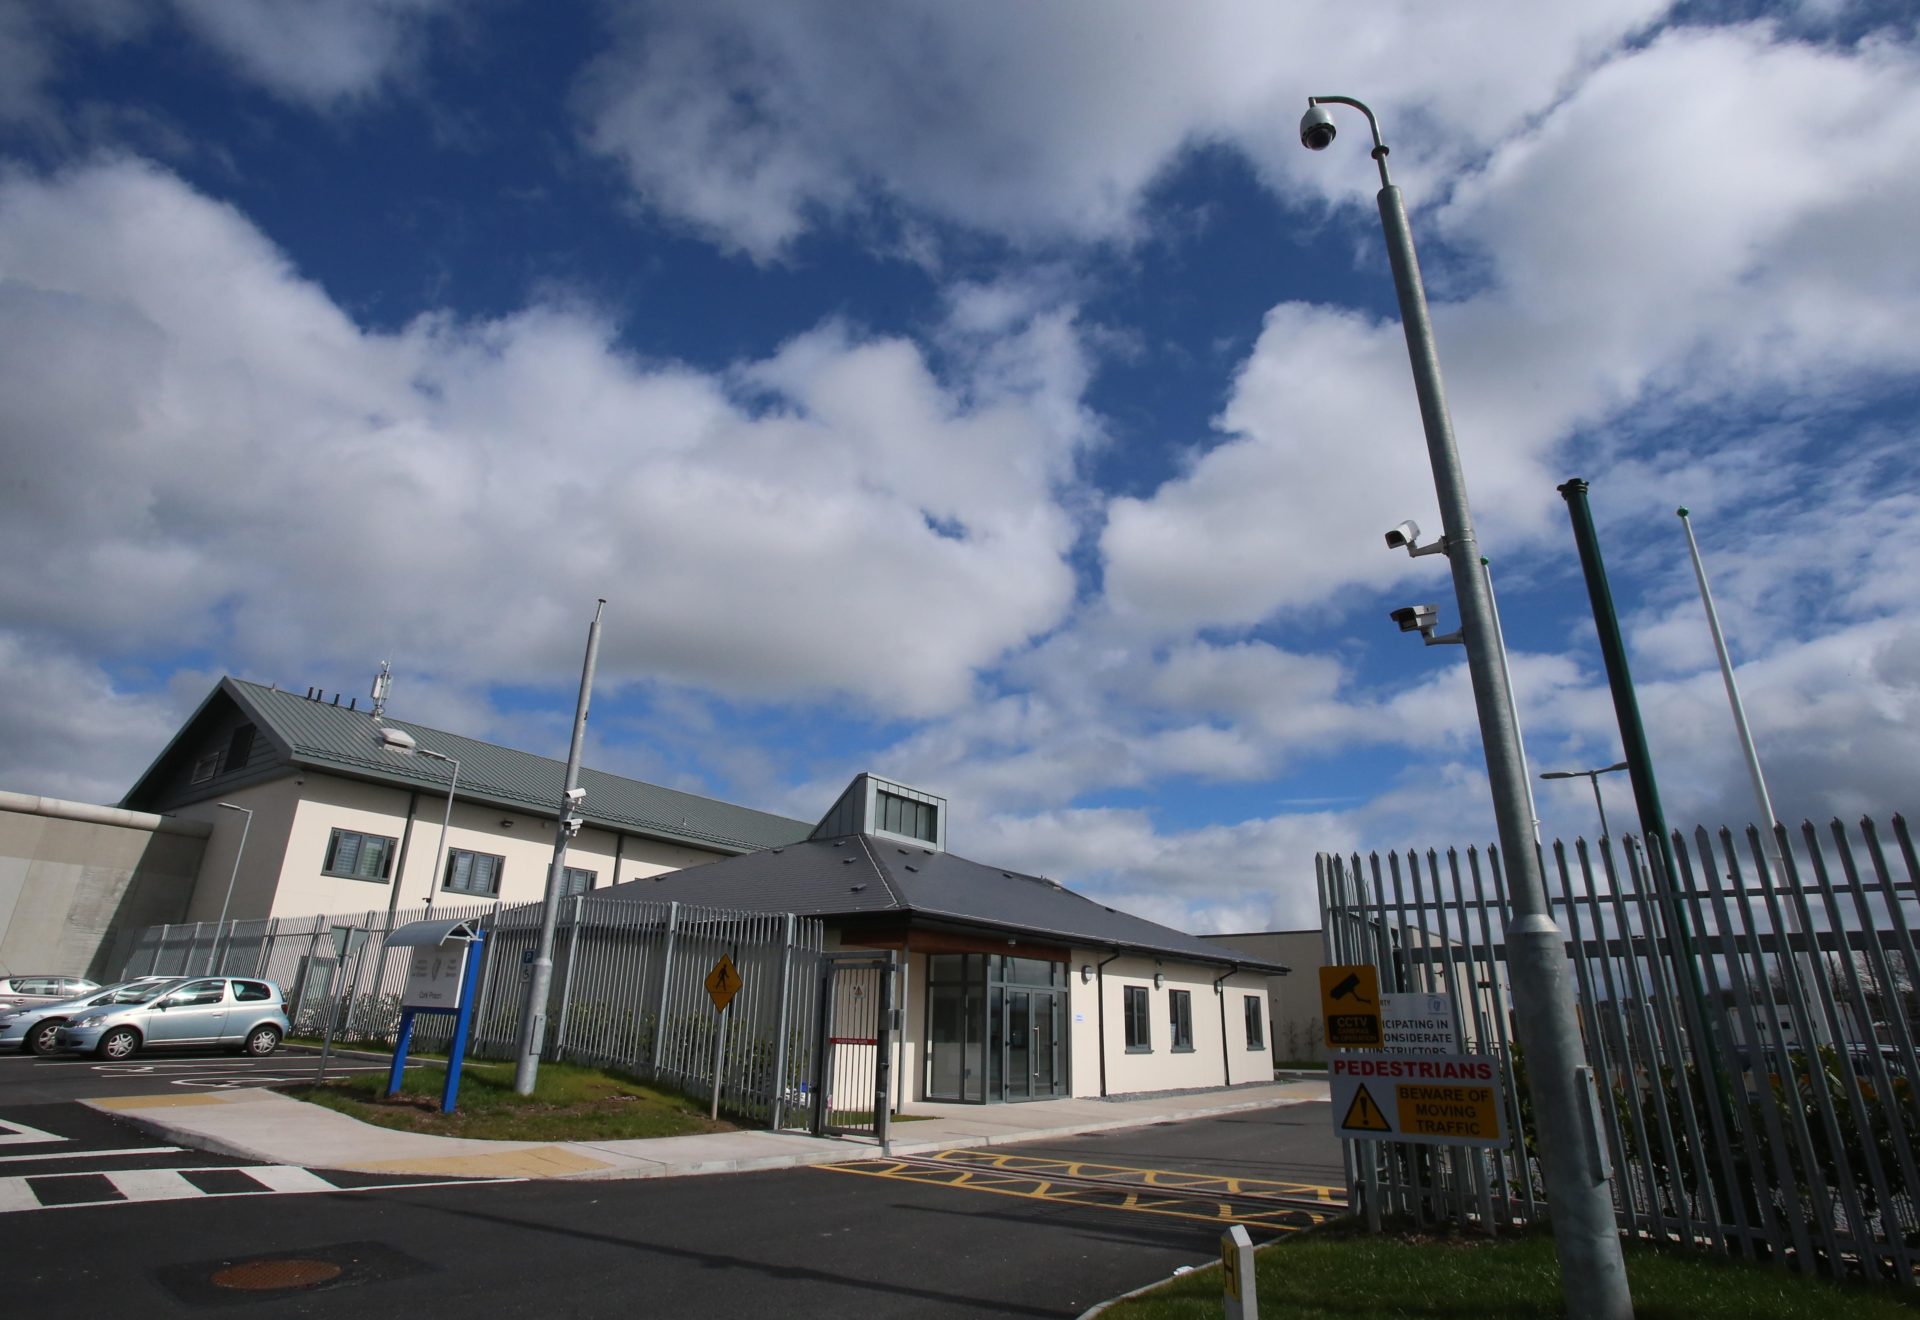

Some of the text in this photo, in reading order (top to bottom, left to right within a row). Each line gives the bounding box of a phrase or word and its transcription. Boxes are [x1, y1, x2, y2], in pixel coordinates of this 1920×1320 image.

[1337, 1017, 1368, 1028] CCTV
[1383, 1020, 1449, 1029] ICIPATING IN
[1384, 1033, 1453, 1043] ONSIDERATE
[1334, 1060, 1492, 1080] PEDESTRIANS
[1400, 1087, 1489, 1102] BEWARE OF
[1416, 1103, 1476, 1118] MOVING
[1416, 1120, 1480, 1135] TRAFFIC
[1223, 1244, 1236, 1294] H
